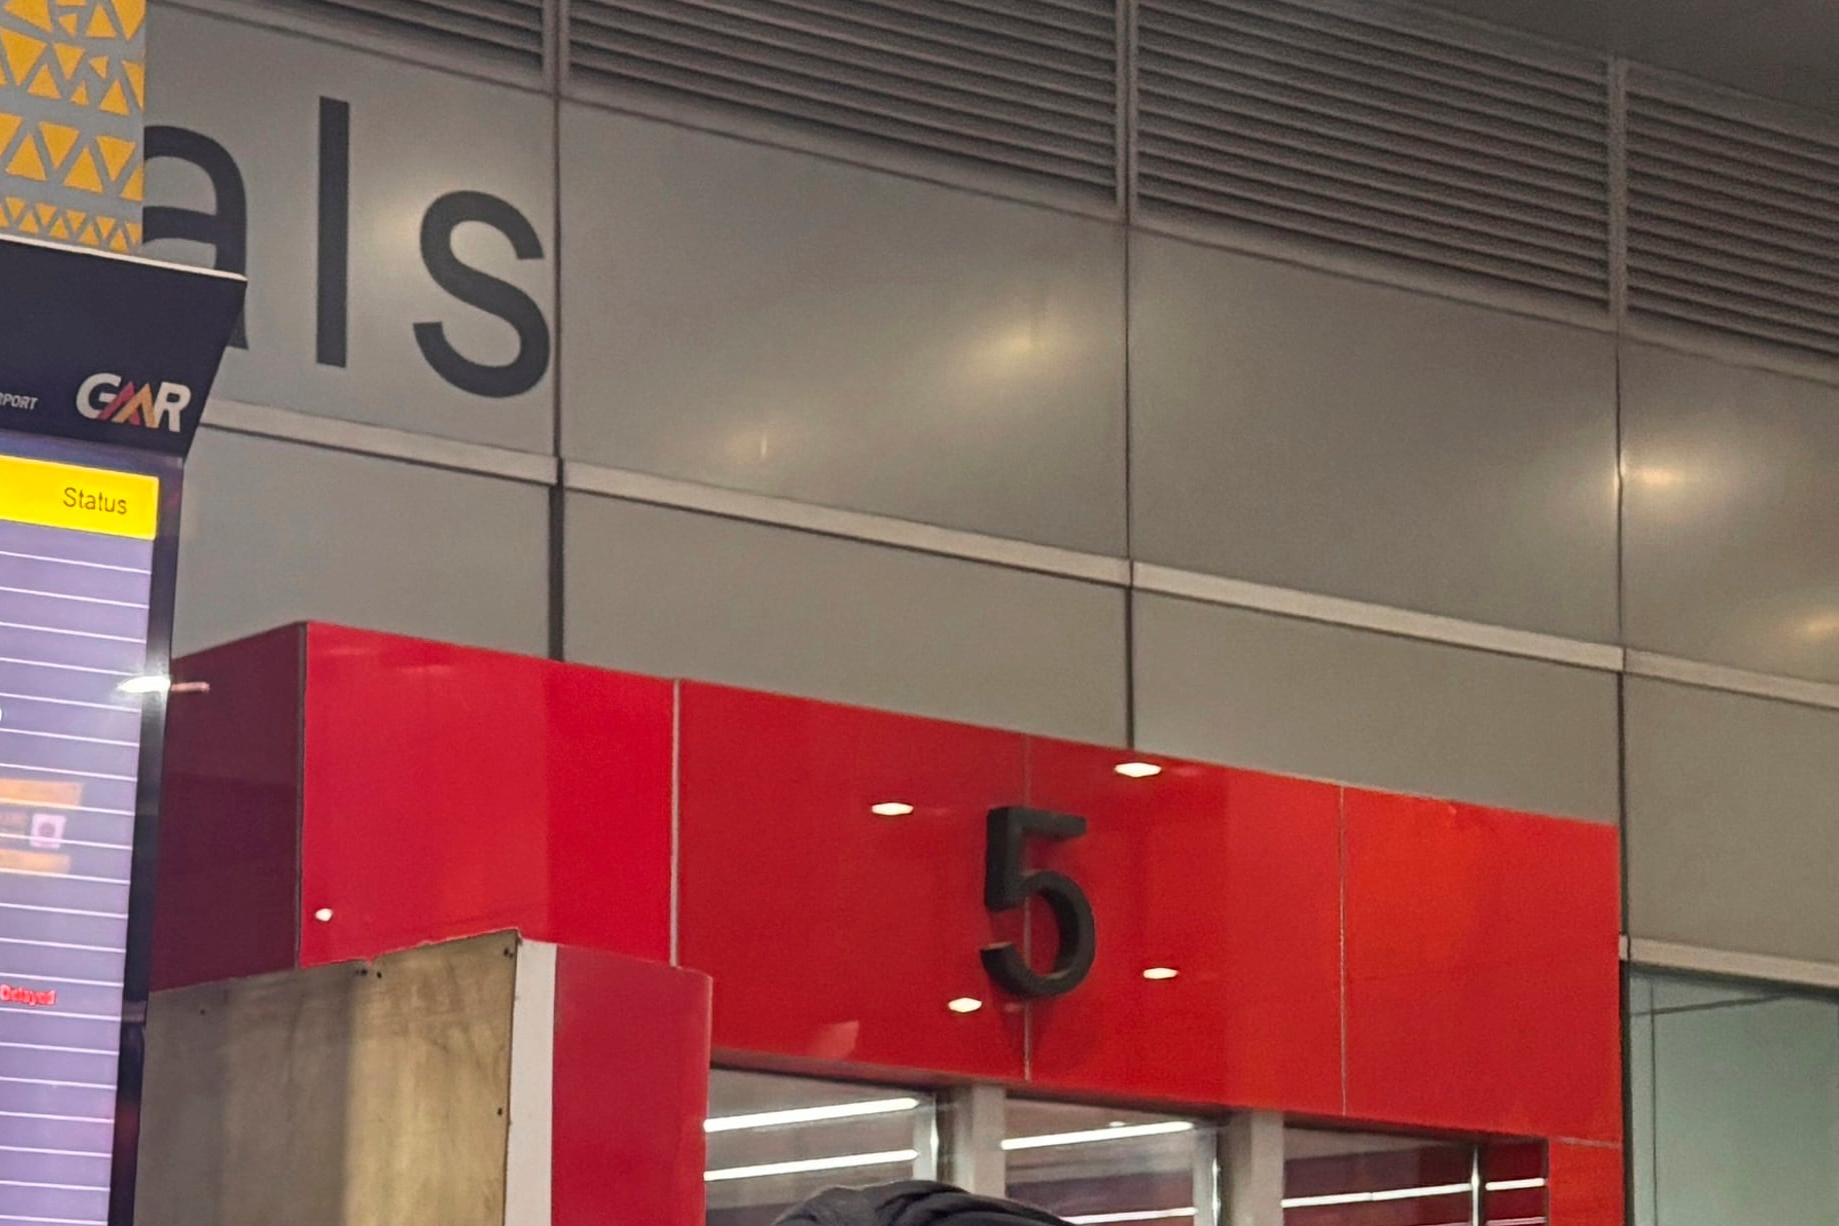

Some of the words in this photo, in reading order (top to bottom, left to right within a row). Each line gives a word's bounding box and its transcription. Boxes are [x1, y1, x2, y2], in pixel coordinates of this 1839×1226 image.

[74, 371, 192, 433] GMR
[62, 486, 126, 516] Status
[977, 804, 1096, 999] 5
